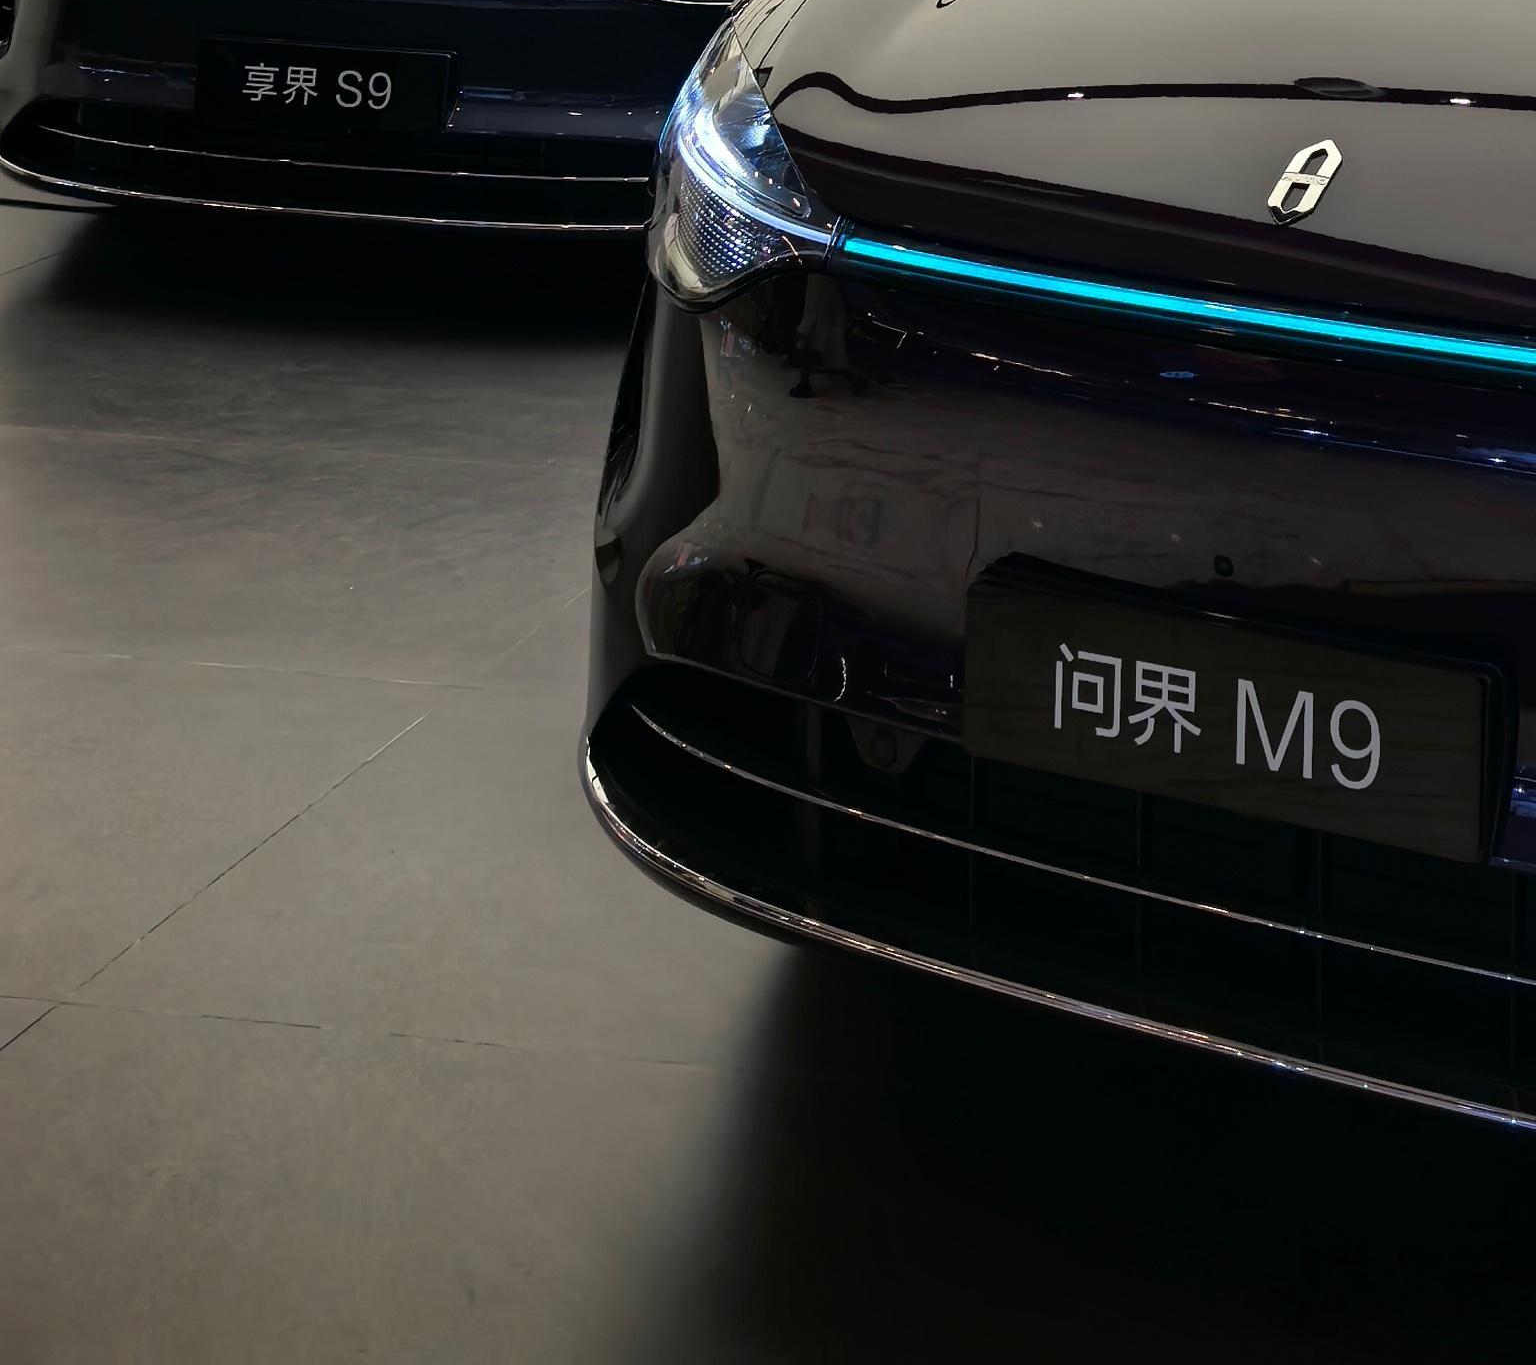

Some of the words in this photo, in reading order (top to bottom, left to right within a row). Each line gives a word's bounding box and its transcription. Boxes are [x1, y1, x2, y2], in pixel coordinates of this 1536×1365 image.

[242, 62, 318, 106] 享界
[335, 69, 392, 110] S9
[1053, 642, 1202, 754] 问界
[1235, 677, 1381, 791] M9
